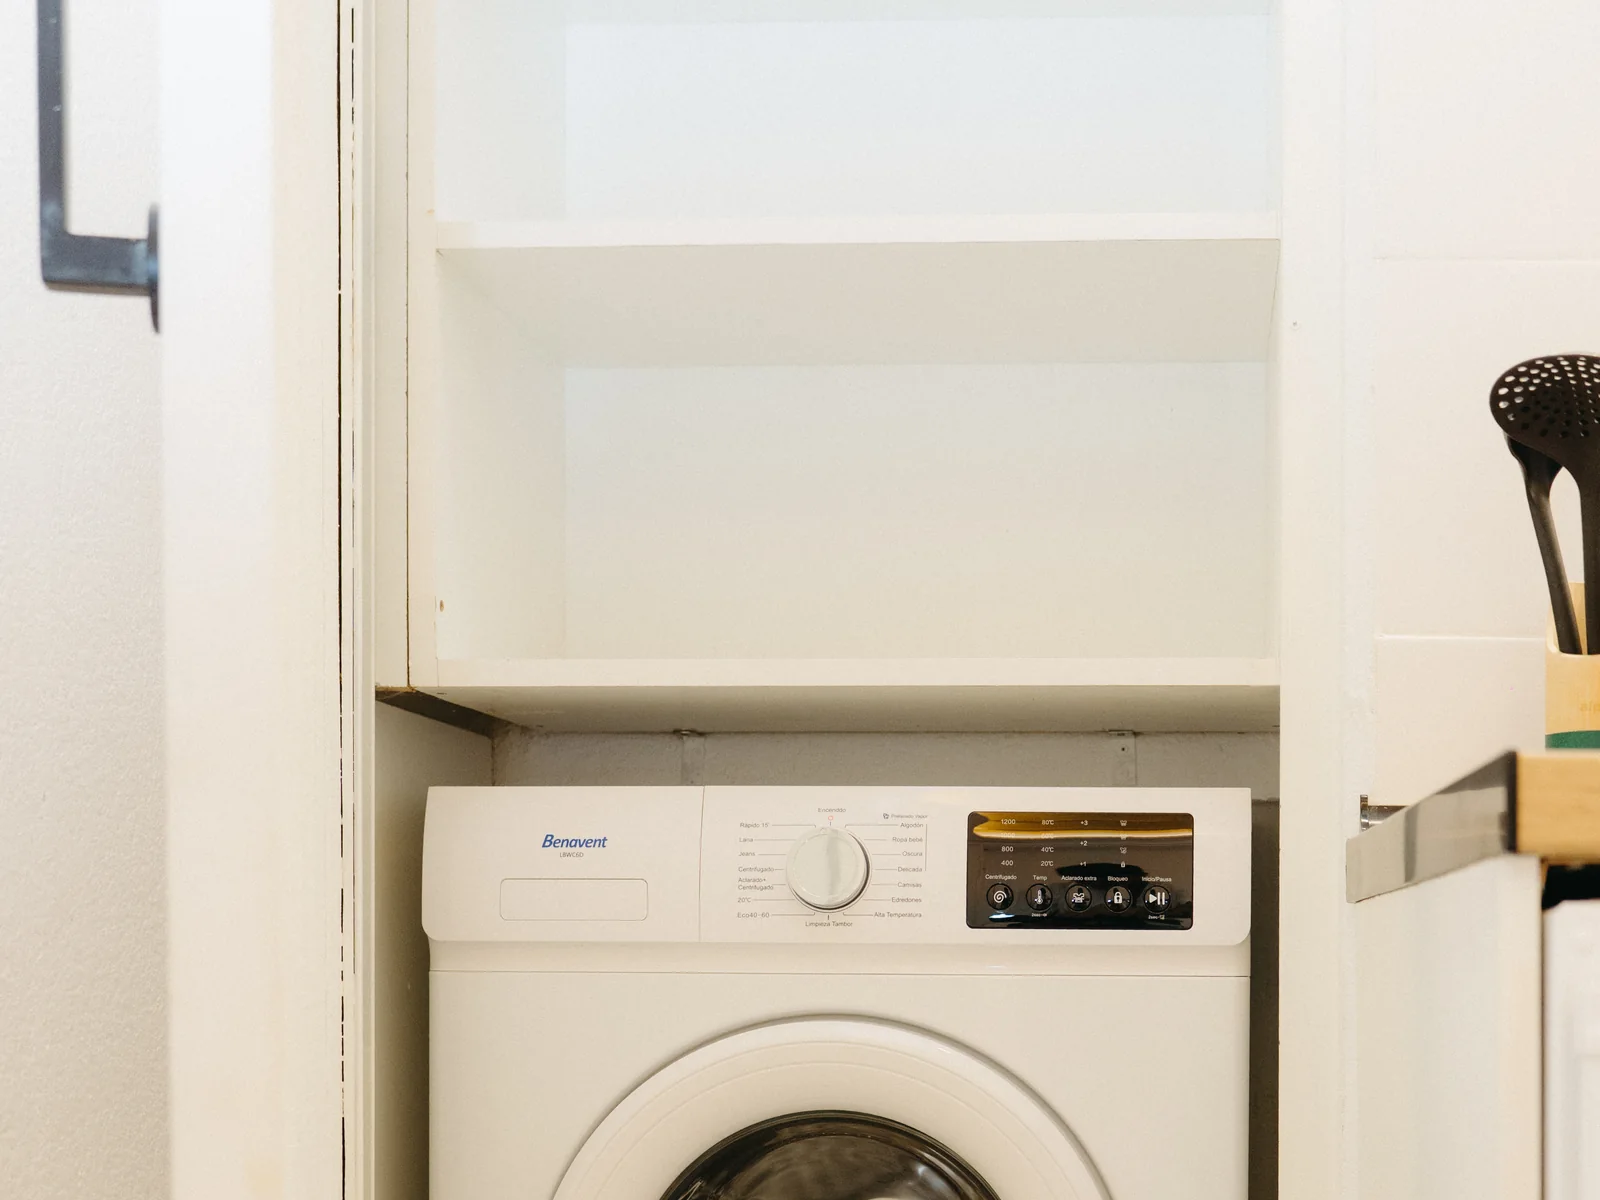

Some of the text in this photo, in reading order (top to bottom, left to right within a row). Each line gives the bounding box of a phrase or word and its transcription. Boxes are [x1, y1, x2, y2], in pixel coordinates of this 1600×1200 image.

[541, 833, 608, 849] Benavent
[892, 836, 908, 844] Ropa
[738, 866, 774, 874] Centrifugado
[887, 911, 922, 919] Temperatura
